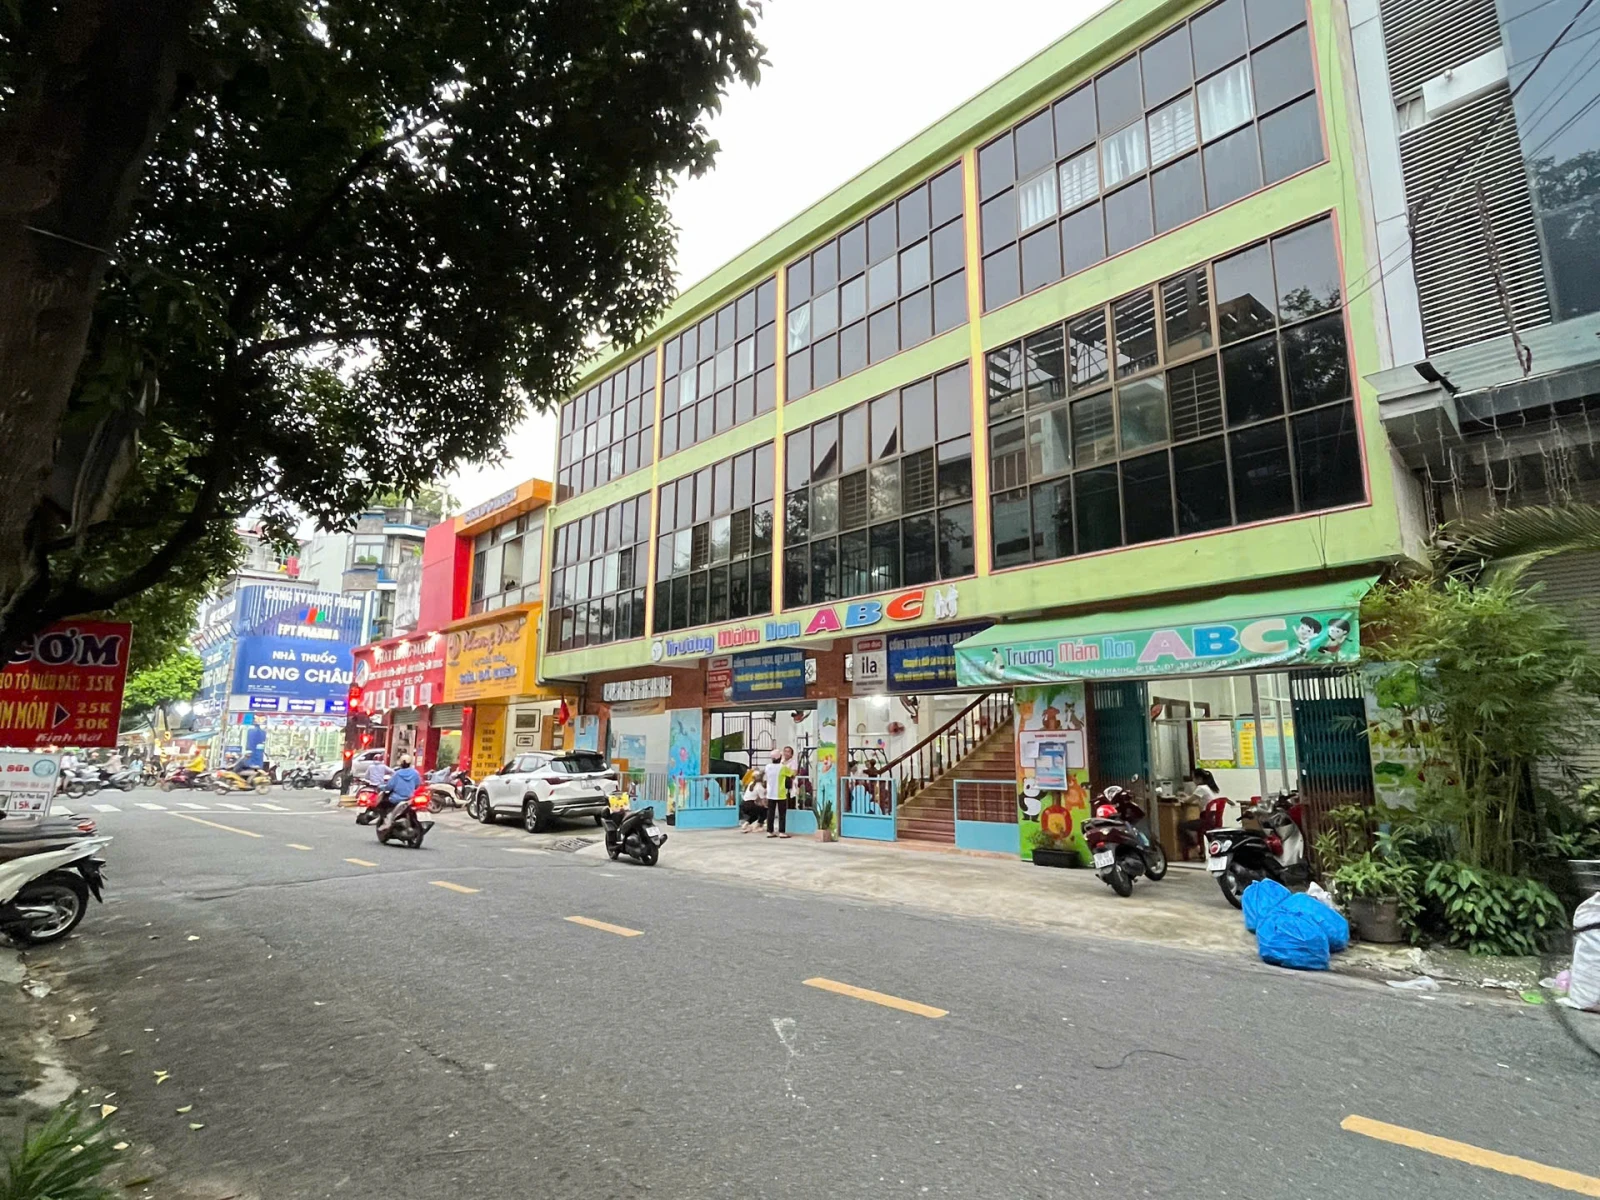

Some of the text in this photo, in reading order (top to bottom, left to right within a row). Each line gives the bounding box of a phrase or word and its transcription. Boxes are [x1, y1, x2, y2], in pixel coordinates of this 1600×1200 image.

[278, 623, 297, 636] FPT
[665, 589, 925, 656] Trường Mầm Non ABC
[1005, 618, 1289, 669] Trường Mầm Non ABC
[272, 649, 338, 664] NHÀ THUỐC
[861, 656, 878, 675] ila
[249, 665, 301, 681] LONG
[304, 668, 354, 685] CHÂU
[77, 702, 112, 714] 25K
[75, 718, 109, 730] 30K
